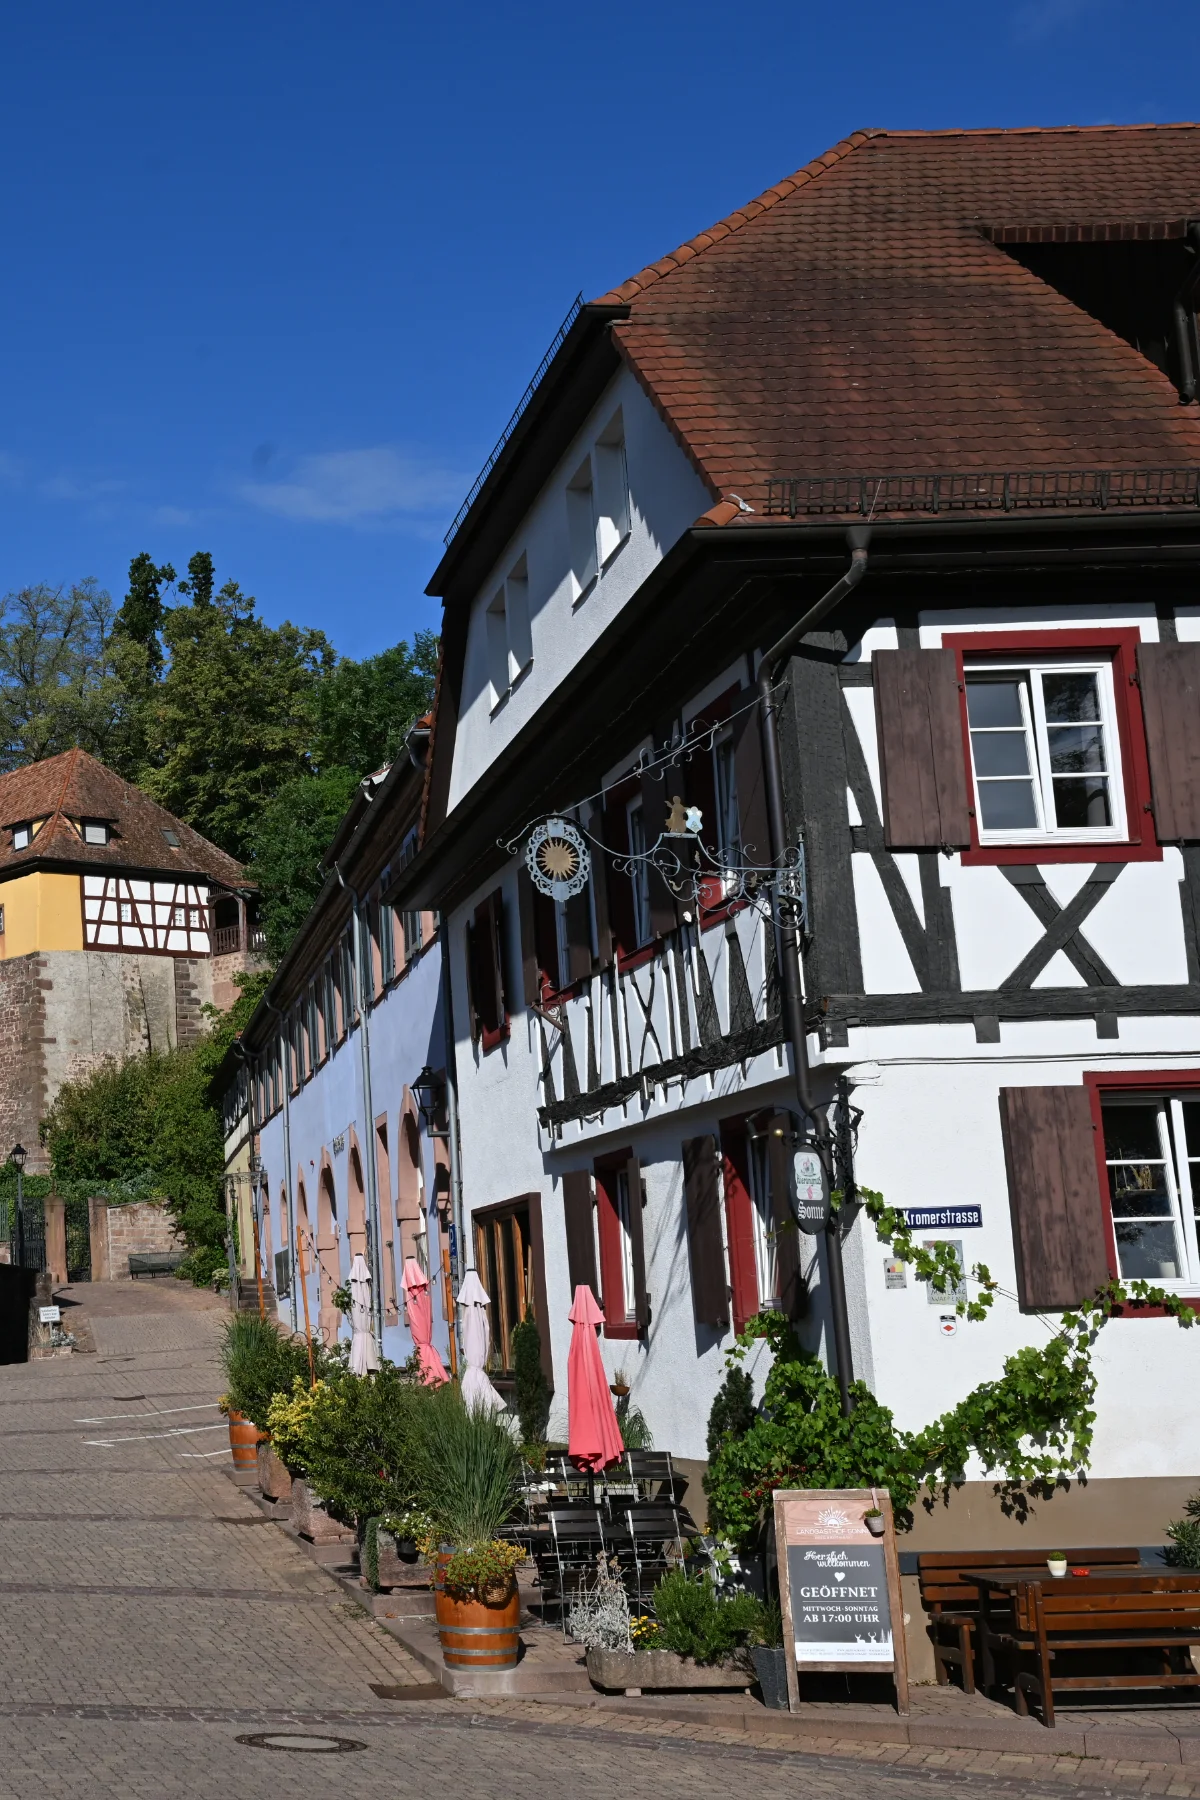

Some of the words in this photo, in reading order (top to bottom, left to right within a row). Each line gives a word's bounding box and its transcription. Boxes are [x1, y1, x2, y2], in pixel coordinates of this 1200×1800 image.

[798, 1201, 824, 1219] Sonne
[903, 1209, 979, 1226] Kromerstrasse
[803, 1551, 848, 1561] Herzlich
[817, 1559, 870, 1567] willkommen
[800, 1585, 878, 1598] GEÖFFNET
[803, 1614, 819, 1622] AB
[822, 1614, 852, 1622] 17:00
[854, 1614, 880, 1622] UHR
